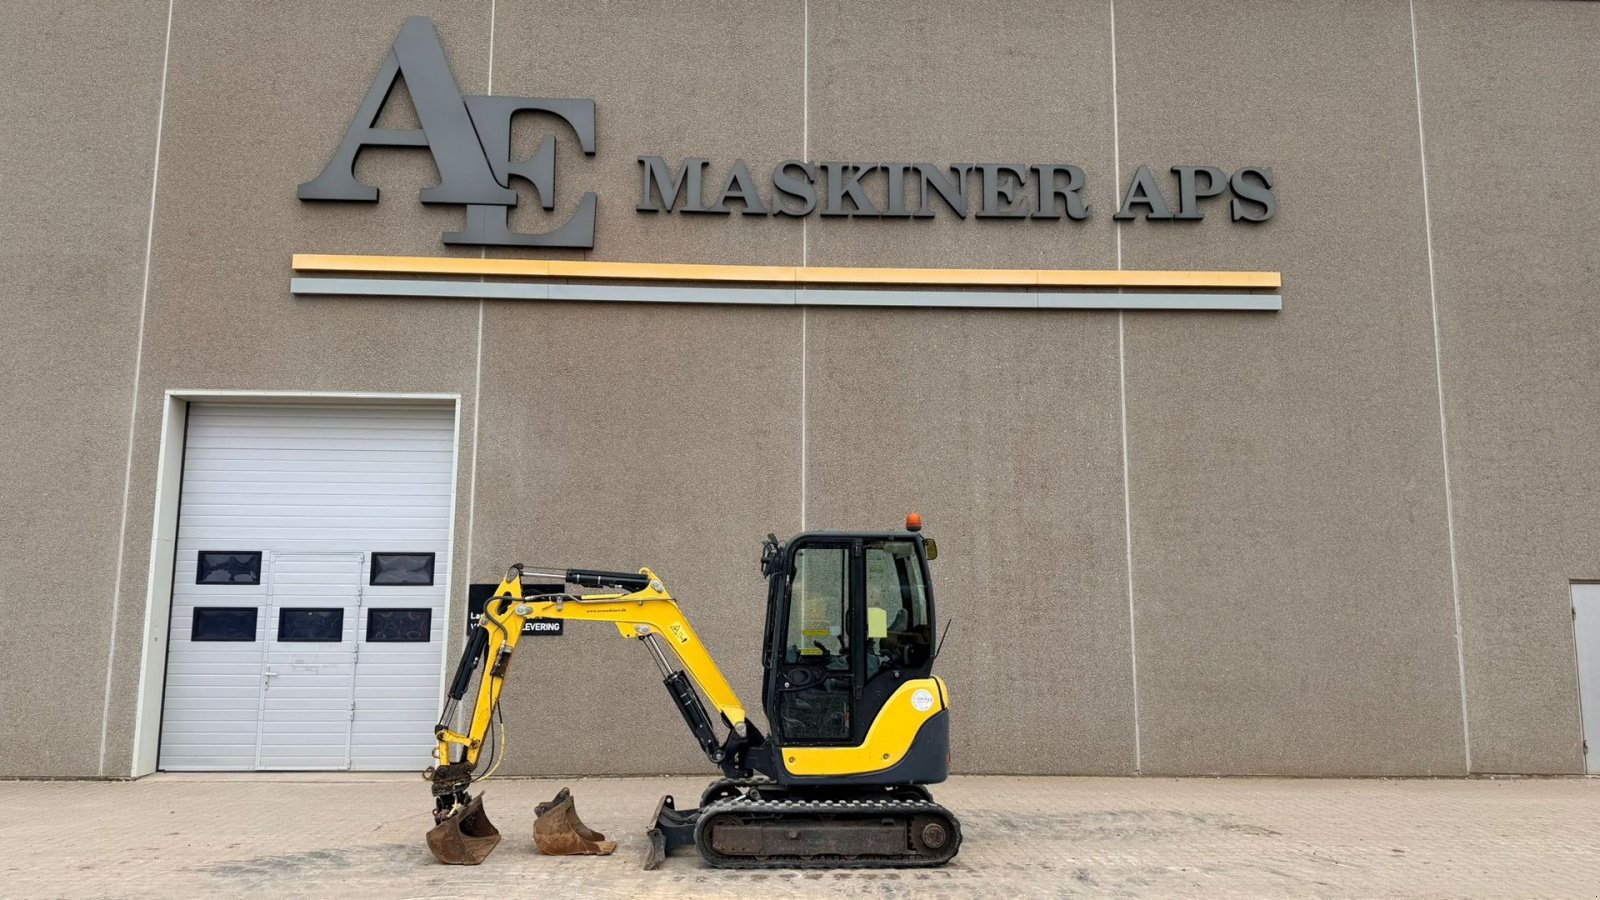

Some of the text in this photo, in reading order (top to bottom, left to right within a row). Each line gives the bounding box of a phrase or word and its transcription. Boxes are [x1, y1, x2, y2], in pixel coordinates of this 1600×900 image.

[297, 16, 1277, 249] AE MASKINER APS
